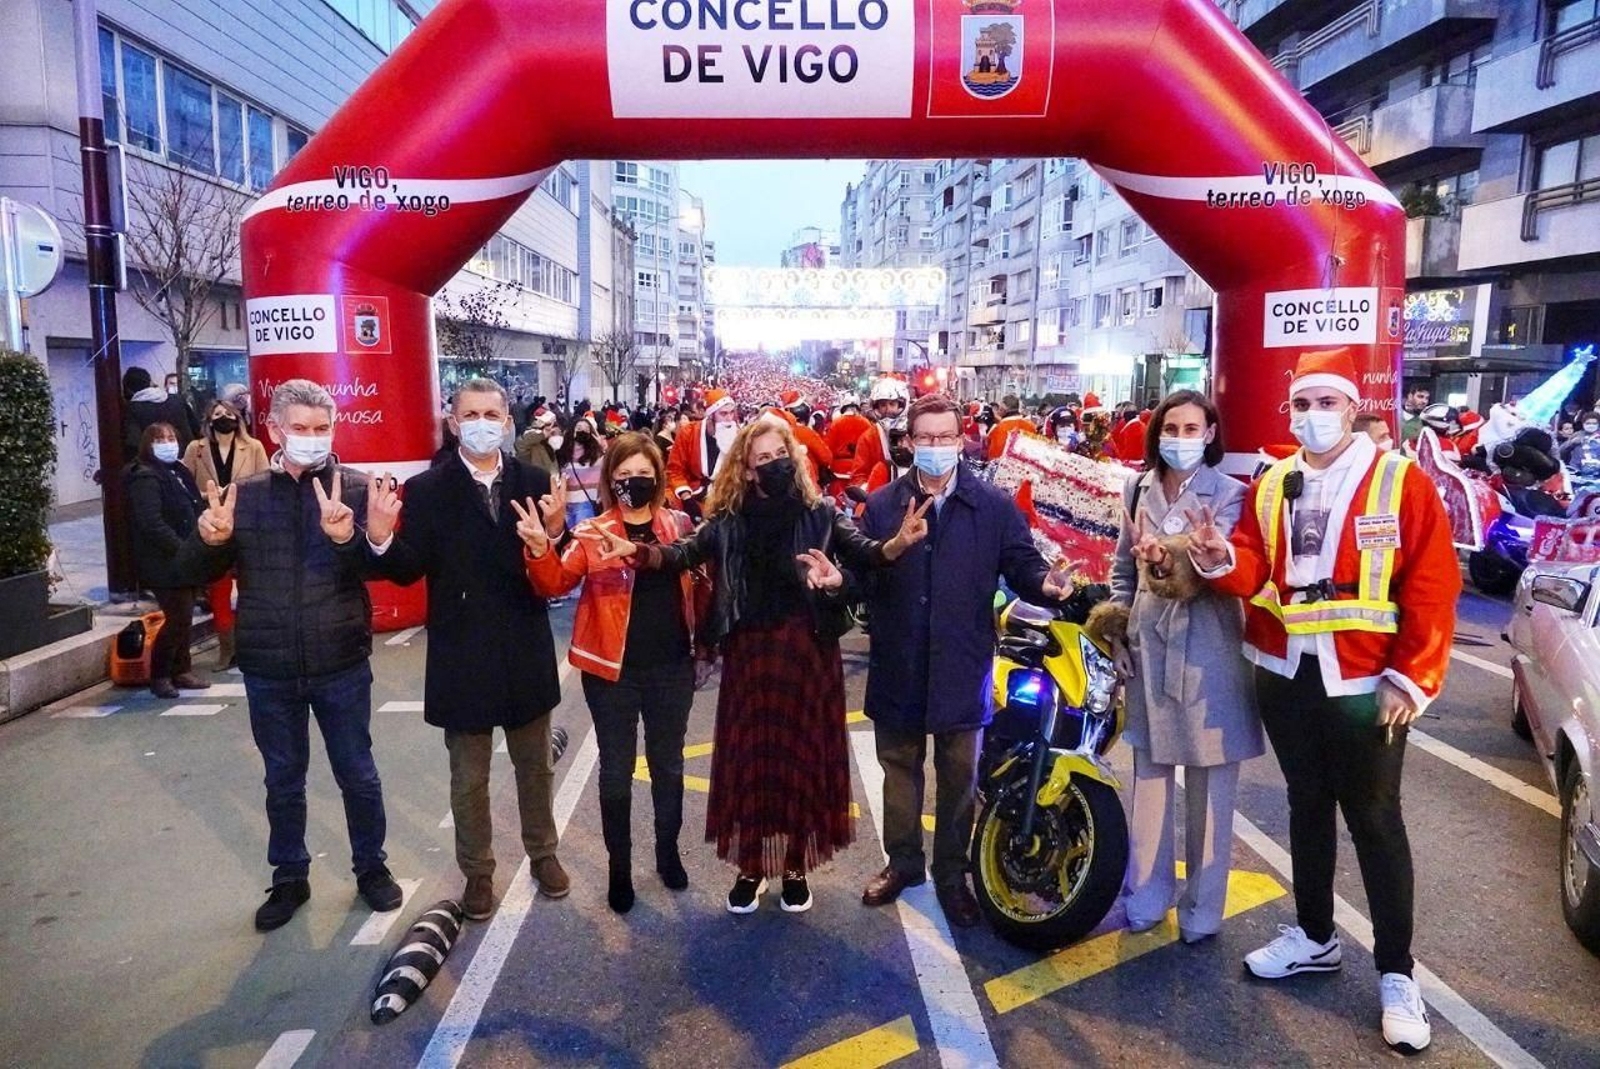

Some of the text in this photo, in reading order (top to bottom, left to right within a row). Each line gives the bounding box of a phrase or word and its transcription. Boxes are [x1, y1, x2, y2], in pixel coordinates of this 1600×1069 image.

[629, 0, 889, 31] CONCELLO
[662, 44, 859, 84] DE VIGO
[333, 165, 399, 193] VIGO,
[1263, 161, 1323, 188] VIGO,
[286, 189, 451, 216] terreo de xogo
[1205, 185, 1367, 210] terreo de xogo
[249, 307, 326, 325] CONCELLO
[1272, 299, 1370, 317] CONCELLO
[255, 325, 315, 342] DE VIGO
[1283, 317, 1360, 335] DE VIGO
